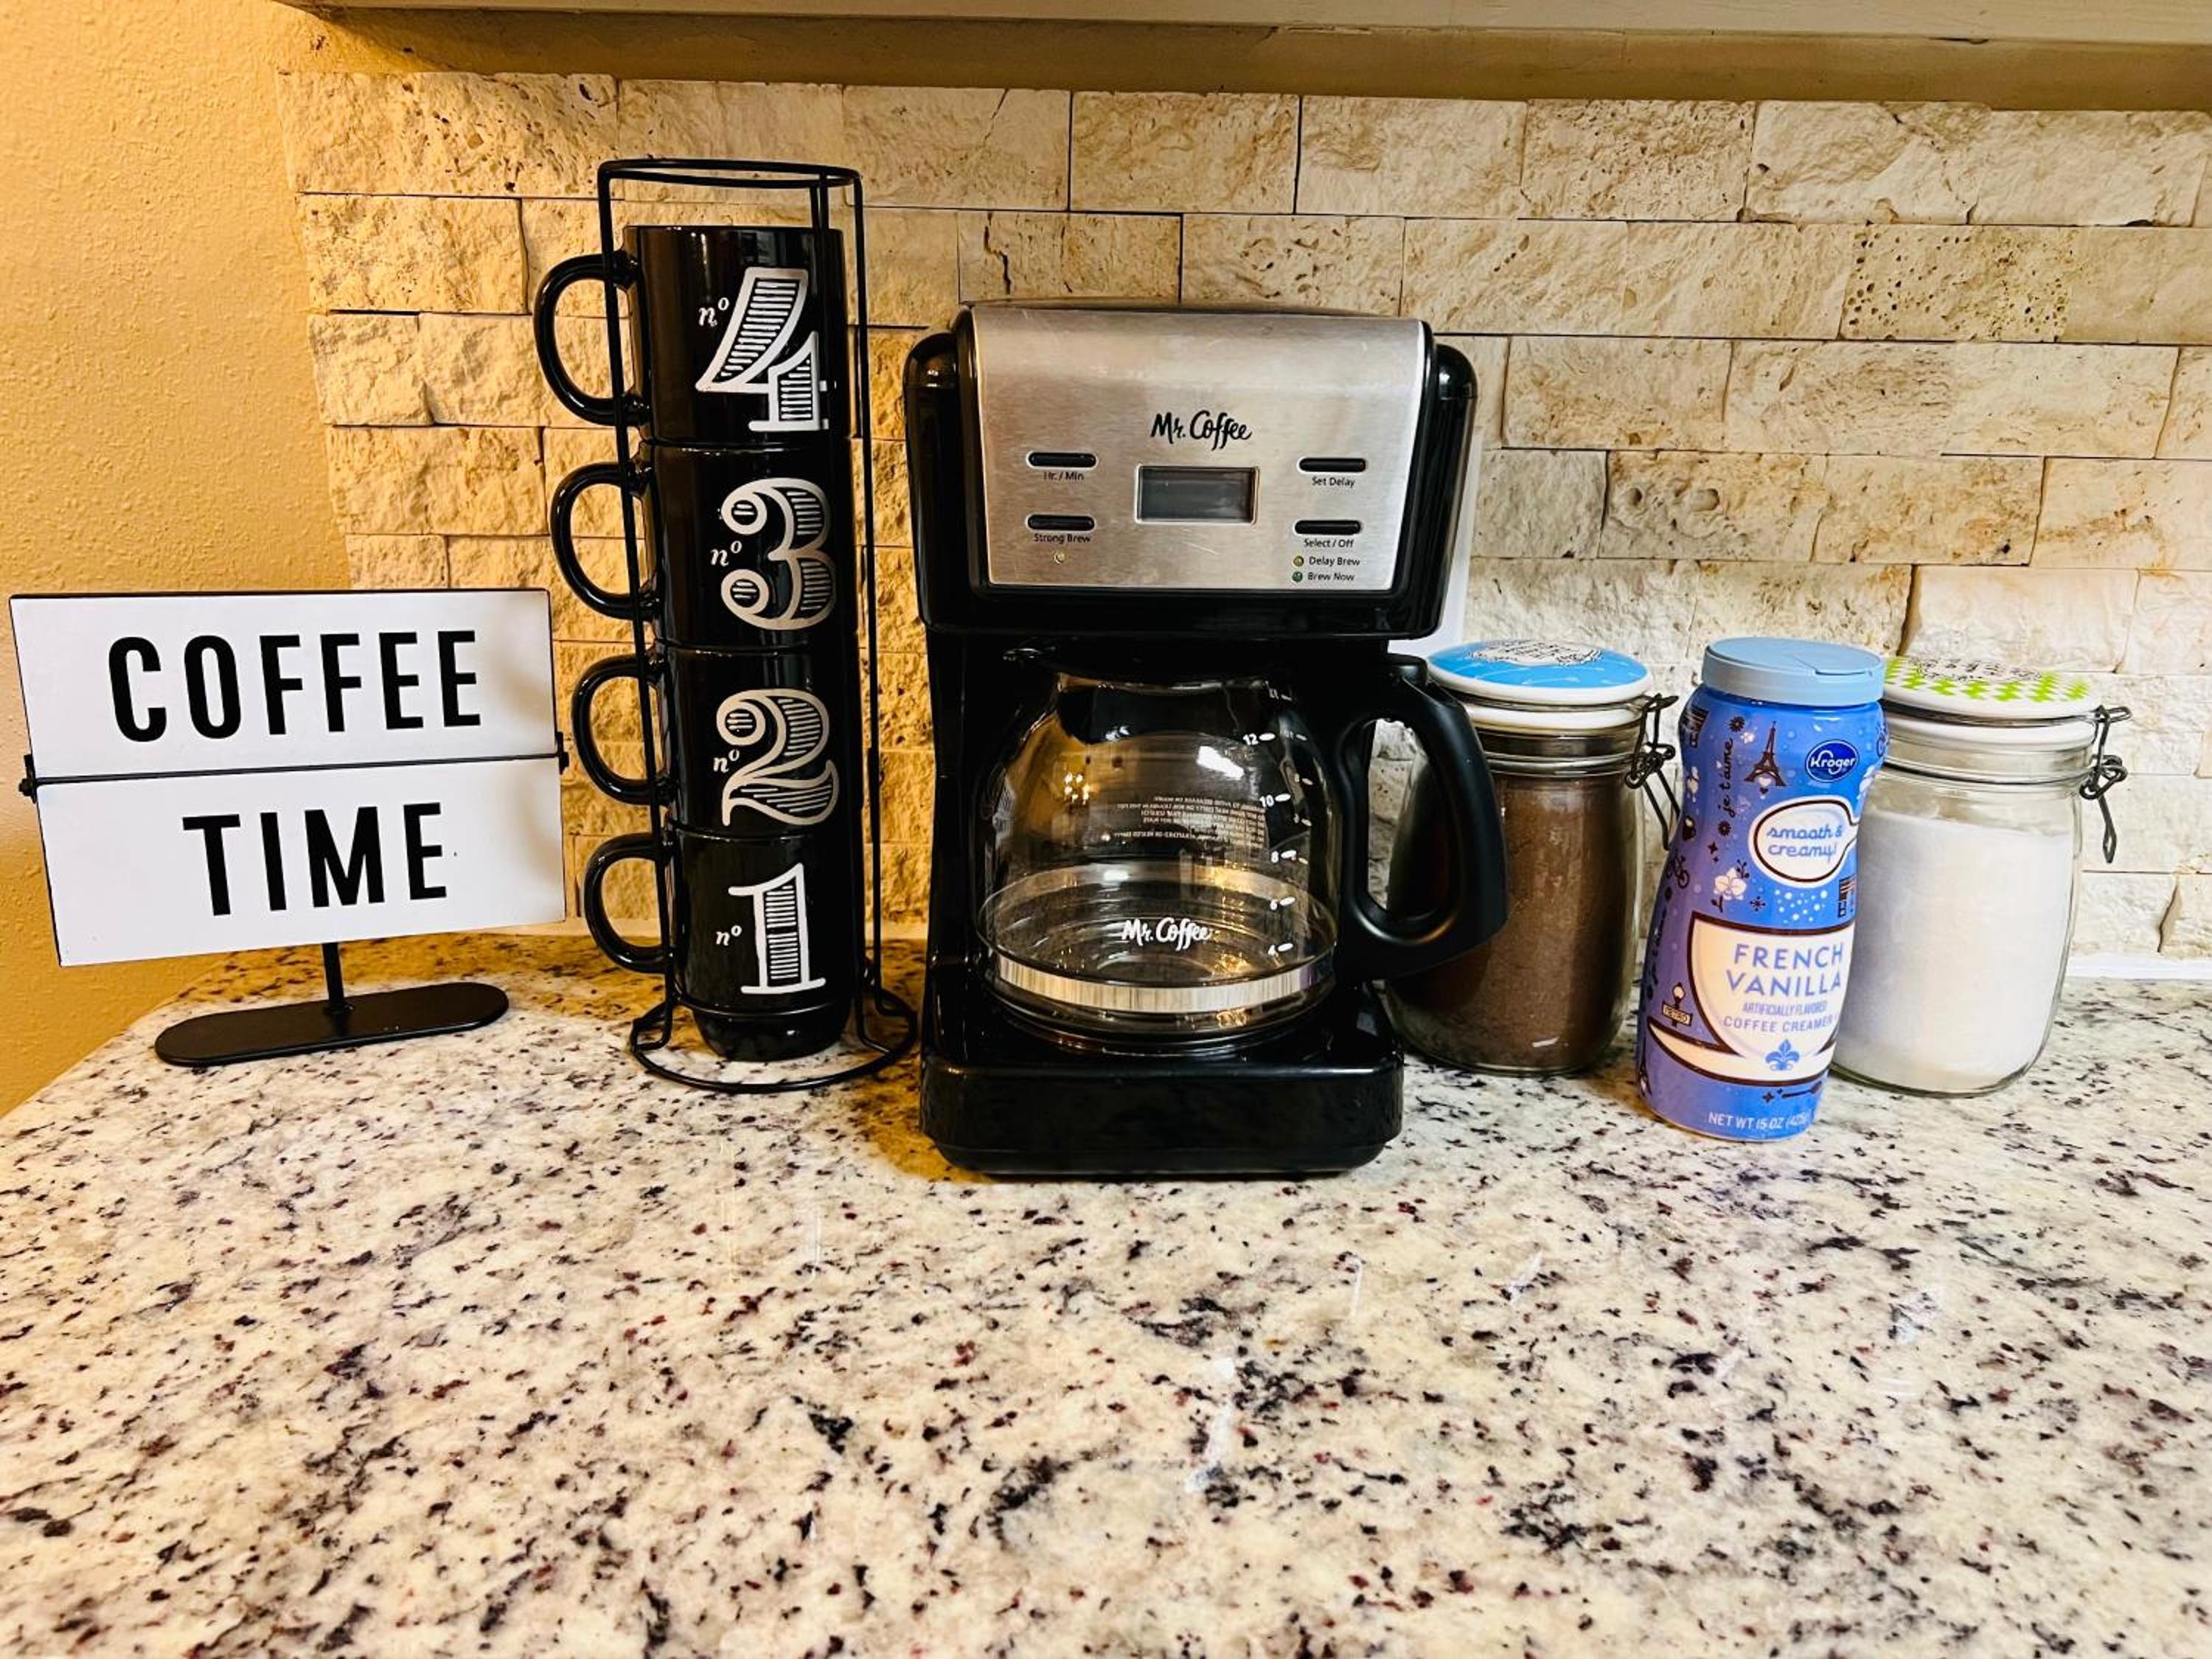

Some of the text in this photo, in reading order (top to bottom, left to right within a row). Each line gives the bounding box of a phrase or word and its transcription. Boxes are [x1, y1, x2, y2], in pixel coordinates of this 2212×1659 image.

[695, 267, 830, 432] 4
[1150, 410, 1252, 450] Mr. Coffee
[1312, 476, 1355, 488] Set Delay
[1034, 532, 1091, 545] Strong Brew
[1304, 538, 1331, 548] Select
[1338, 539, 1354, 548] Off
[720, 477, 836, 630] 3
[1309, 556, 1360, 566] Delay Brew
[1307, 571, 1355, 580] Brew Now
[108, 630, 481, 742] COFFEE
[1243, 733, 1259, 745] 12
[716, 688, 839, 827] 2
[1810, 750, 1856, 775] Kroger
[1259, 794, 1274, 807] 10
[1767, 824, 1833, 839] smooth
[183, 802, 447, 917] TIME
[1270, 851, 1279, 863] 8
[728, 862, 826, 995] 1
[1121, 917, 1212, 951] Mr. Coffee
[1733, 942, 1843, 970] FRENCH
[1726, 970, 1841, 997] VANILLA
[1723, 1014, 1834, 1032] COFFEE CREAMER
[1708, 1112, 1733, 1126] NET
[1736, 1116, 1755, 1130] WT
[1769, 1116, 1783, 1130] OZ
